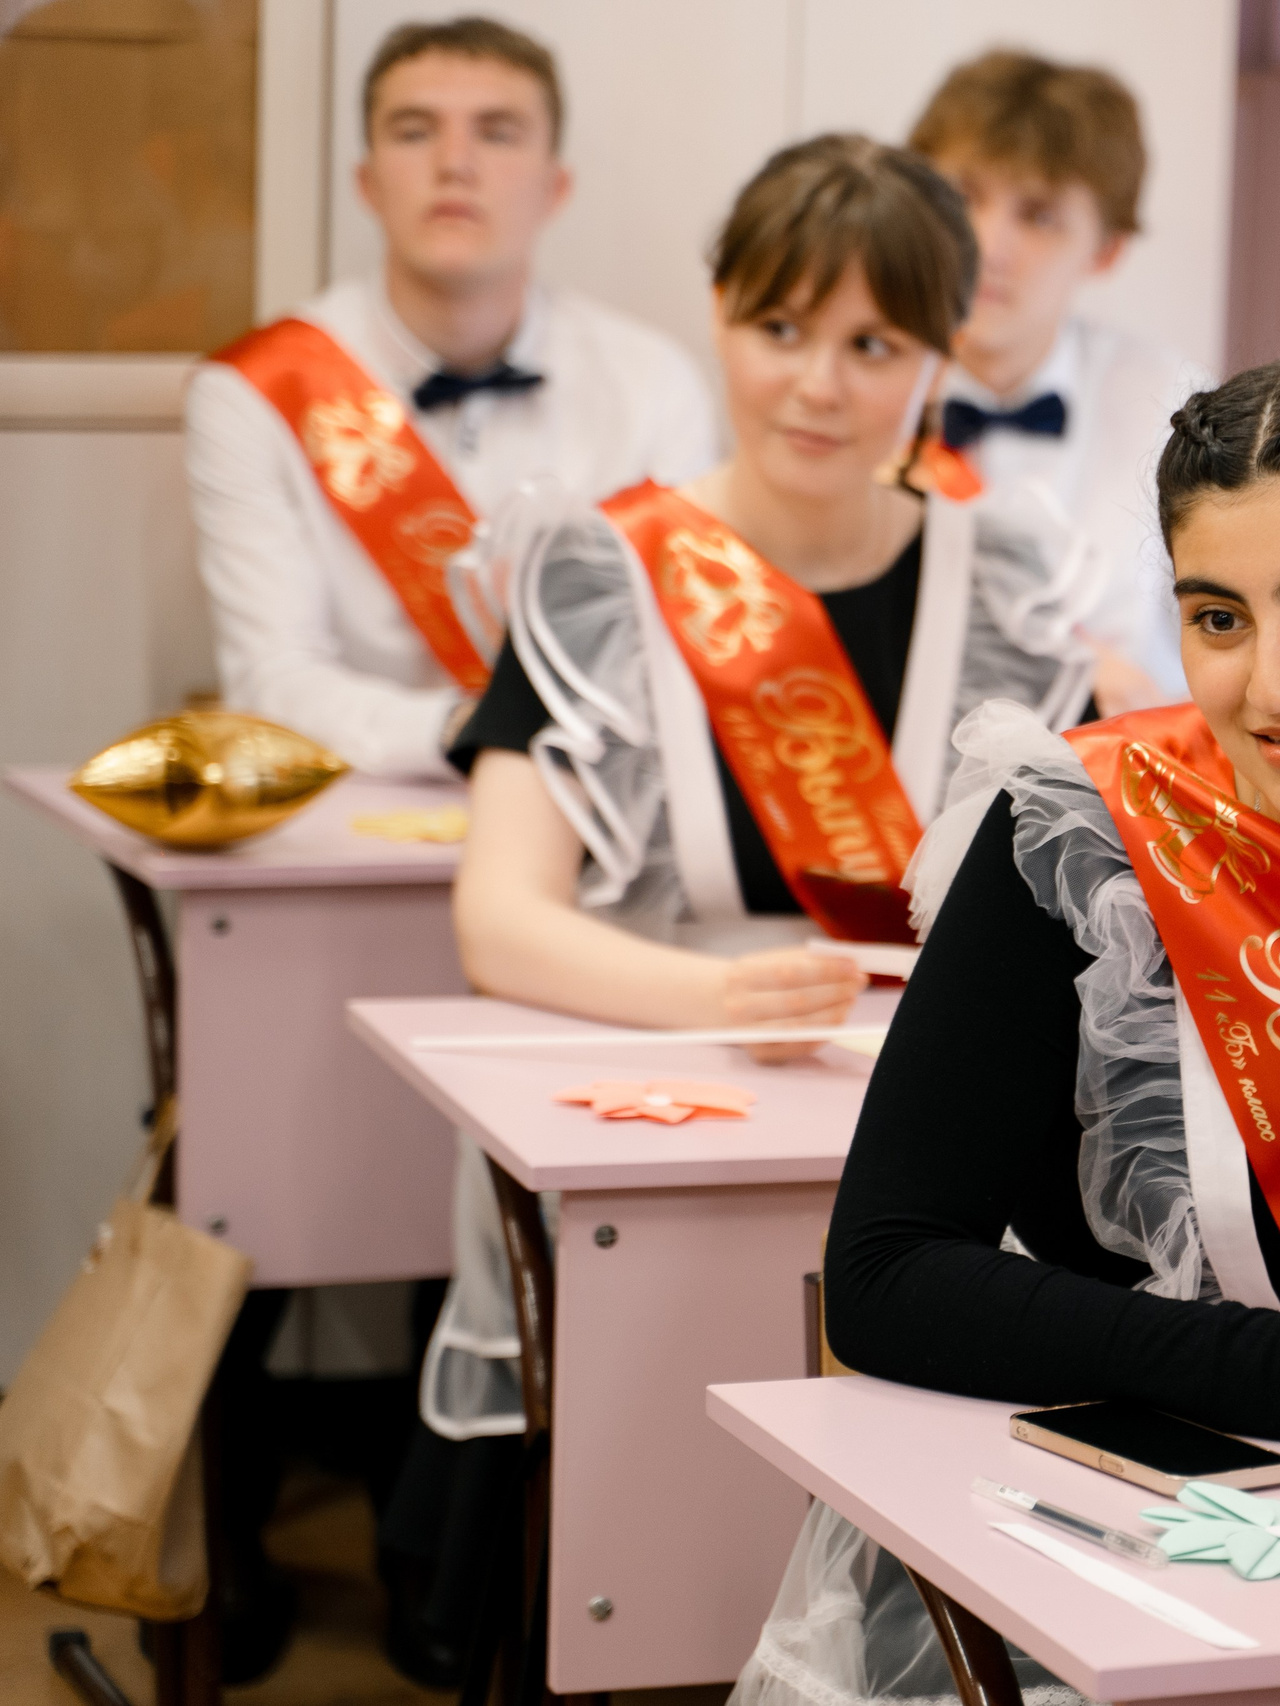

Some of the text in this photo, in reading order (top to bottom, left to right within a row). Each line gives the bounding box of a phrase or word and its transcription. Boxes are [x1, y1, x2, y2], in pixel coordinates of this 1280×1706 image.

[1197, 968, 1276, 1142] 11 «Б» класс
